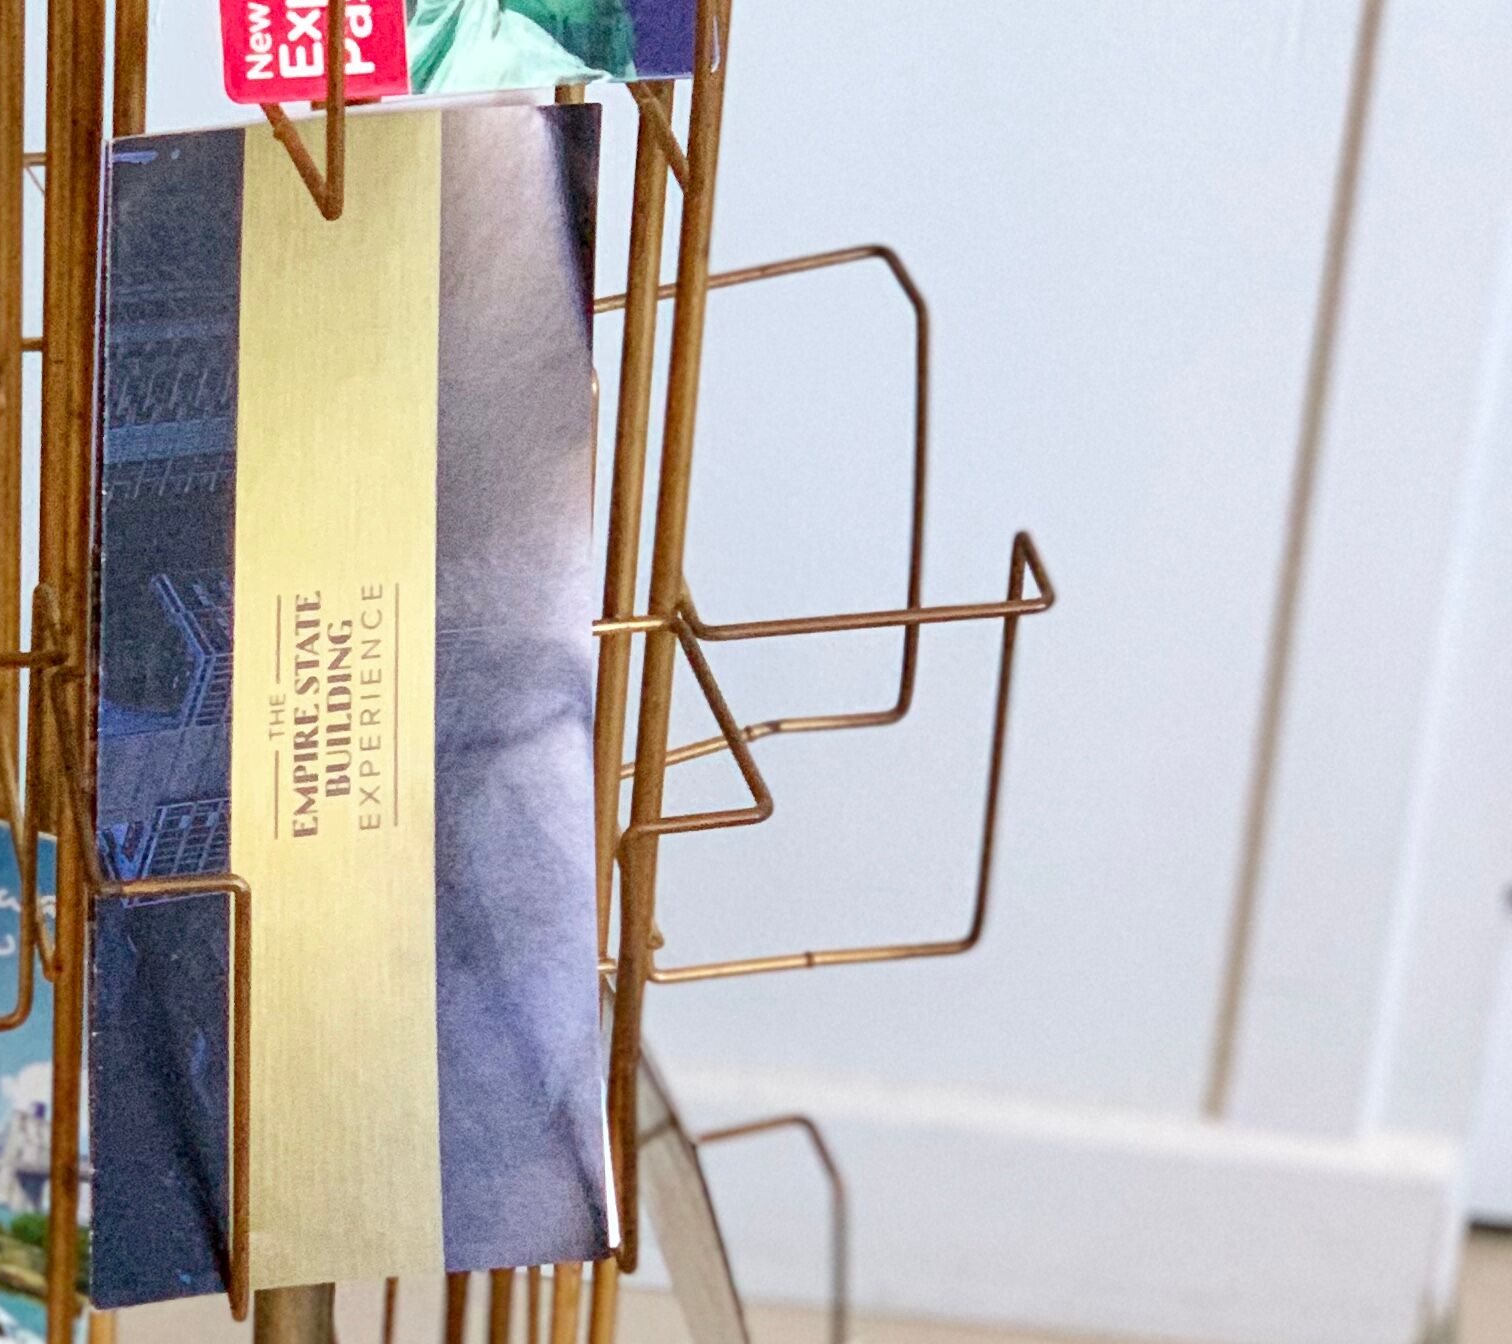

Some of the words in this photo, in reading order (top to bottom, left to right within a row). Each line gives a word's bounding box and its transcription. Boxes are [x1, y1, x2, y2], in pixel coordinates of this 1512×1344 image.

[244, 1, 274, 80] New
[293, 589, 321, 695] STATE
[268, 693, 285, 741] THE
[324, 619, 353, 798] BUILDING
[358, 582, 383, 830] EXPERIENCE
[291, 702, 319, 838] EMPIRE
